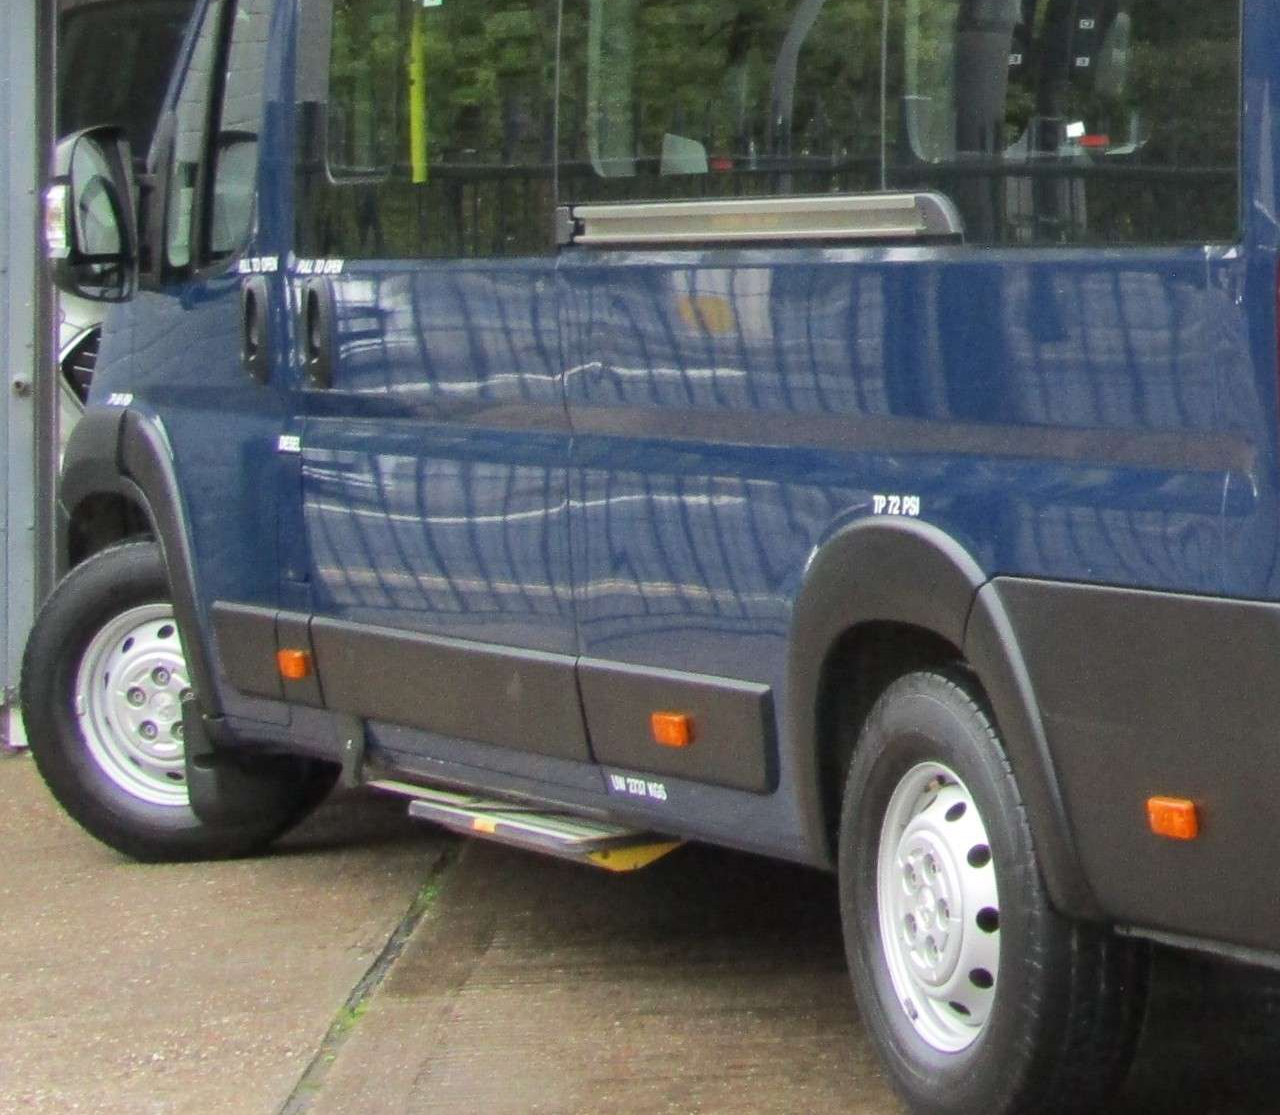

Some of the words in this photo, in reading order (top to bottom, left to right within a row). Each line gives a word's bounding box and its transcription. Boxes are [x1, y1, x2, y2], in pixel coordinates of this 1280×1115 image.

[873, 495, 887, 514] TP
[887, 495, 901, 515] 72
[902, 496, 920, 516] PSI
